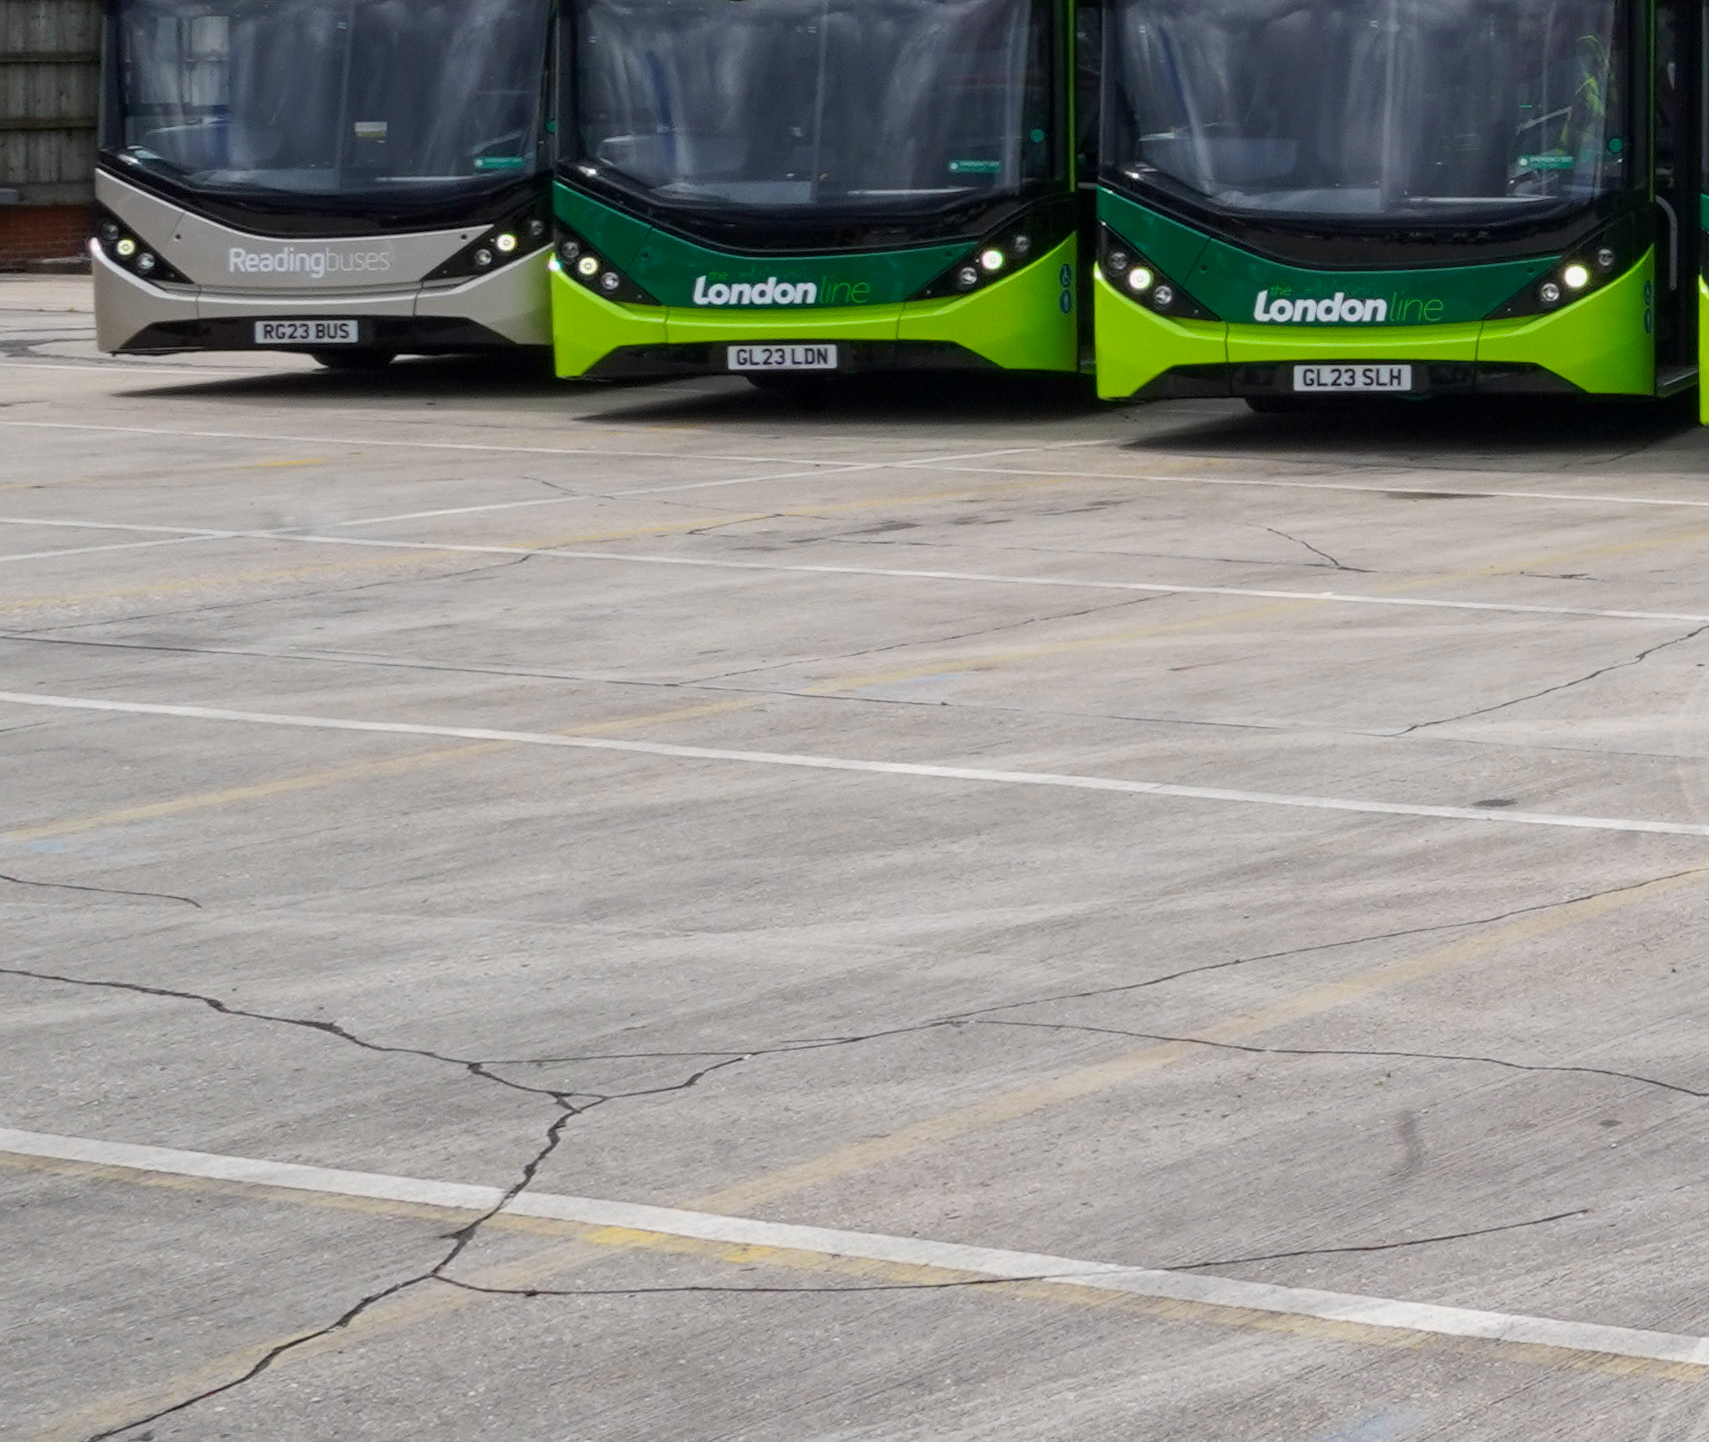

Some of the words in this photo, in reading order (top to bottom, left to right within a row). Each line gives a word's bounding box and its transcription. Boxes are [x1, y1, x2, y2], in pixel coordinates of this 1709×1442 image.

[692, 275, 818, 305] London
[1253, 289, 1388, 323] London
[263, 323, 310, 340] RG23
[315, 323, 350, 339] BUS
[736, 348, 786, 366] GL23
[791, 348, 828, 365] LDN
[1302, 368, 1356, 387] GL23
[1362, 368, 1402, 387] SLH
